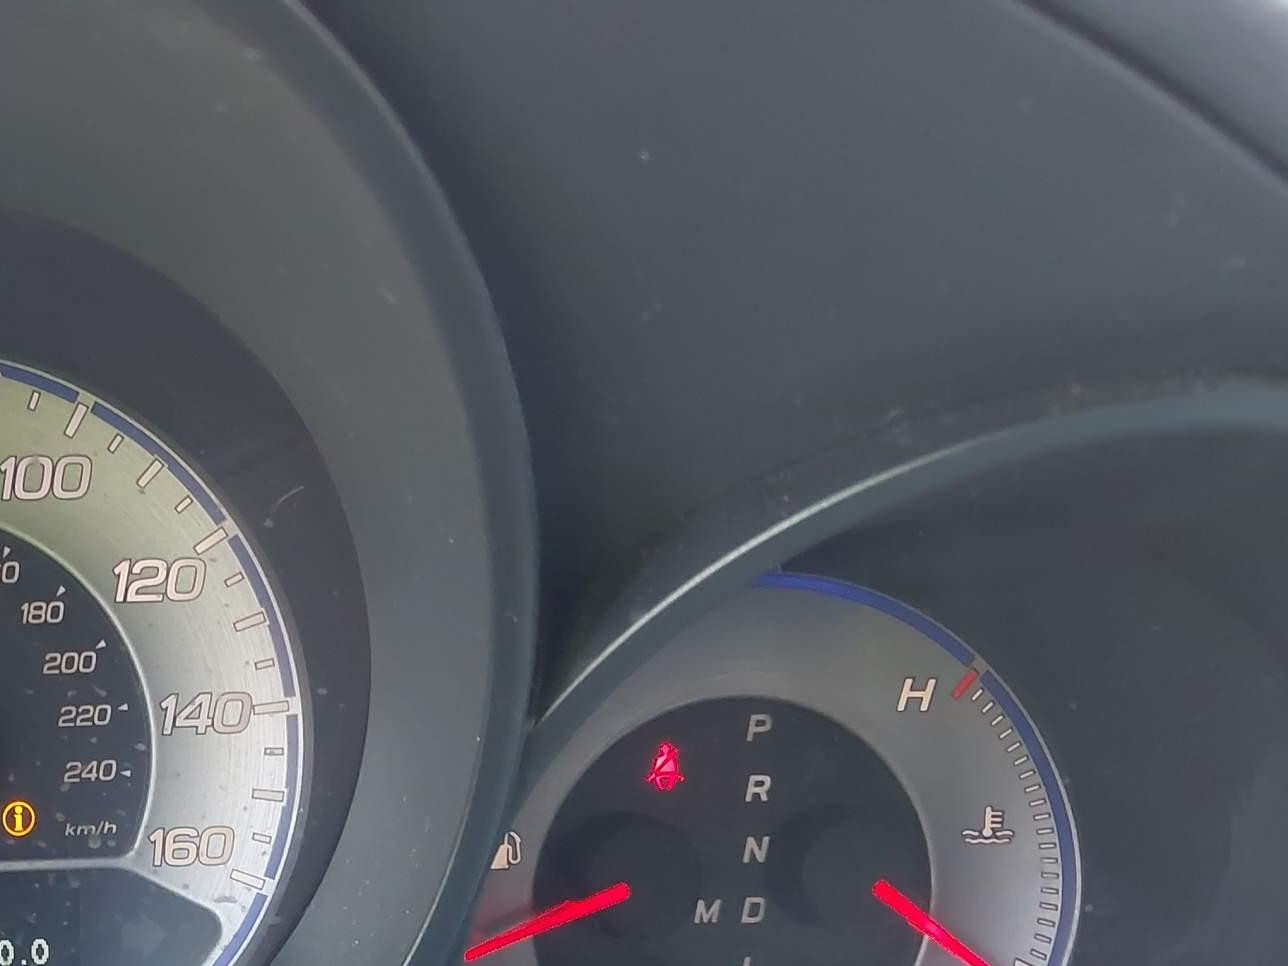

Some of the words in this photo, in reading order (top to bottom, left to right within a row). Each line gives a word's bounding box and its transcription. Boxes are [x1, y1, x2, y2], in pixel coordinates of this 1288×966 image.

[0, 455, 93, 501] 100
[112, 557, 207, 603] 120
[20, 601, 64, 624] 180
[43, 652, 97, 675] 200
[896, 677, 938, 712] H
[58, 704, 112, 728] 220
[159, 692, 253, 736] 140
[745, 713, 774, 742] P
[64, 759, 117, 783] 240
[744, 774, 772, 803] R
[65, 822, 117, 837] km/h
[149, 825, 236, 867] 160
[743, 836, 771, 865] N
[693, 900, 722, 925] M
[740, 896, 766, 924] D
